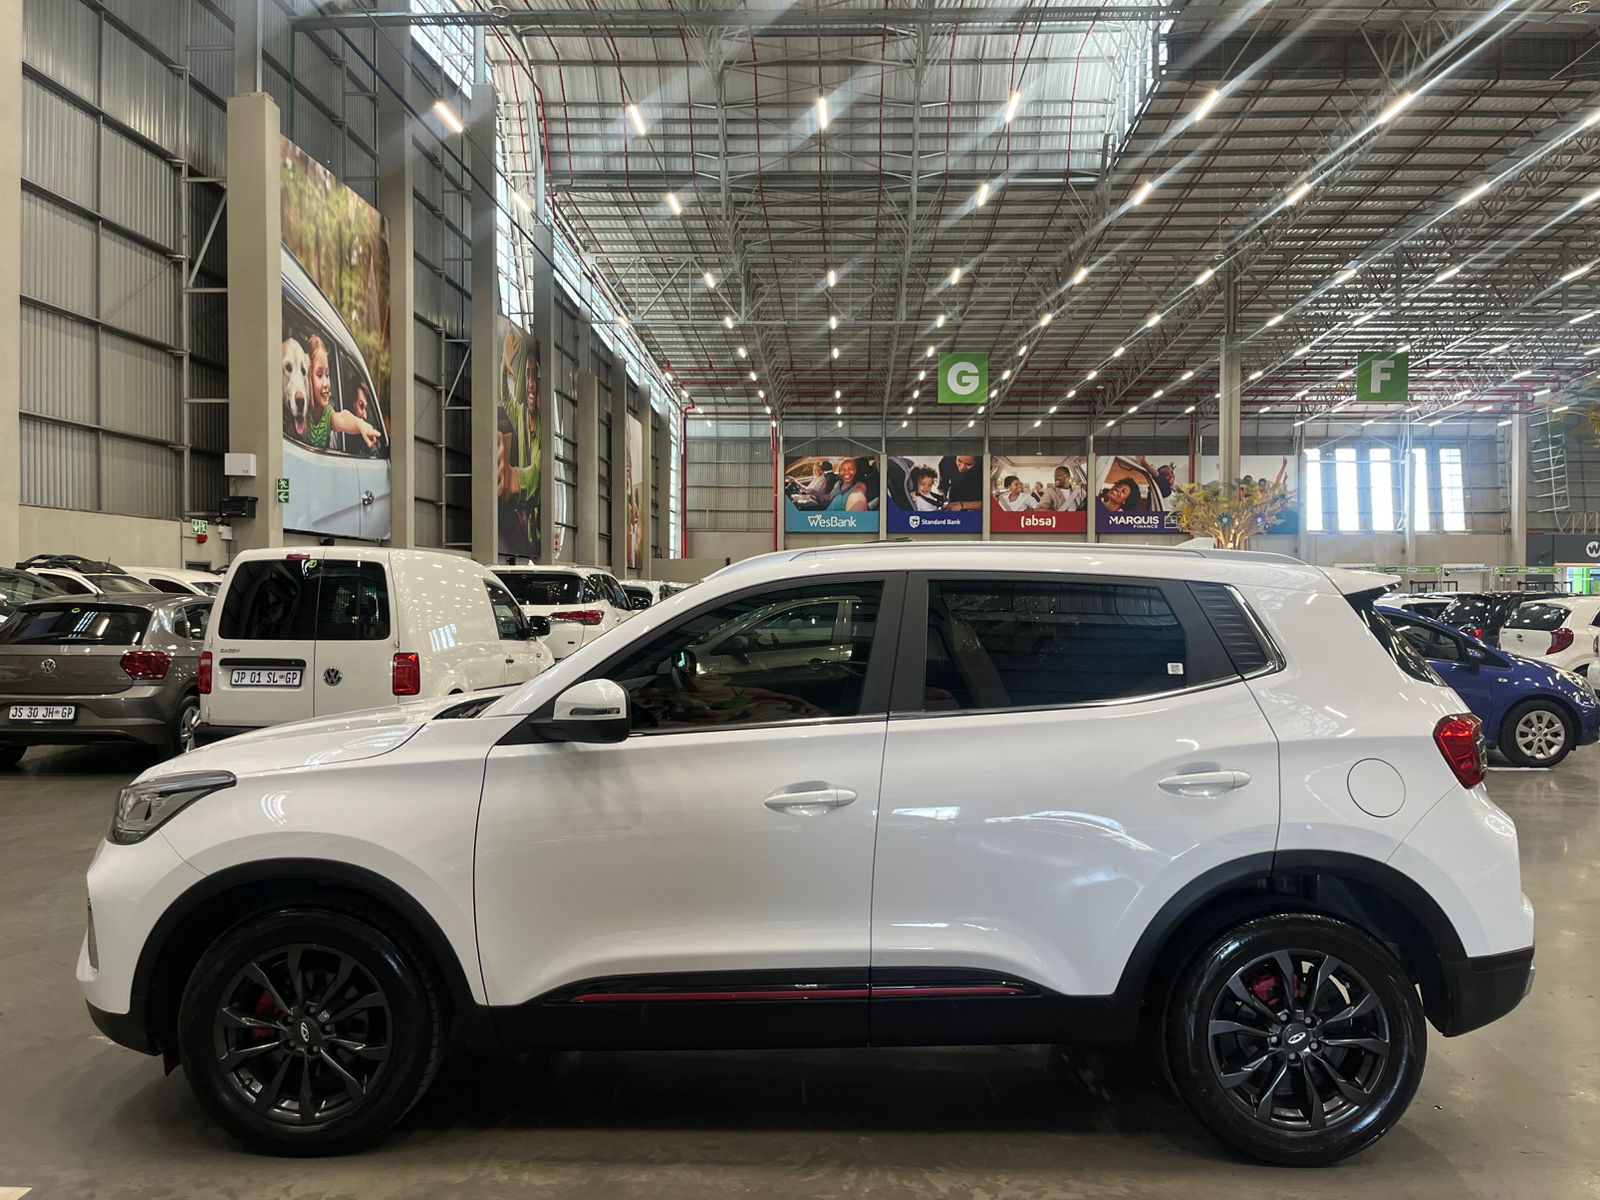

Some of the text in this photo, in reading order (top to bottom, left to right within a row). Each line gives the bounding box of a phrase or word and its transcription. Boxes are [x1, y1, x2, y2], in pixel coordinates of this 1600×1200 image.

[947, 361, 980, 396] G
[1370, 359, 1395, 394] F
[807, 514, 857, 528] WesBank
[1020, 515, 1057, 528] (absa)
[1109, 515, 1160, 525] MARQUIS
[234, 671, 298, 684] JP 01 SL GP
[12, 706, 73, 718] JS 30 JH GP
